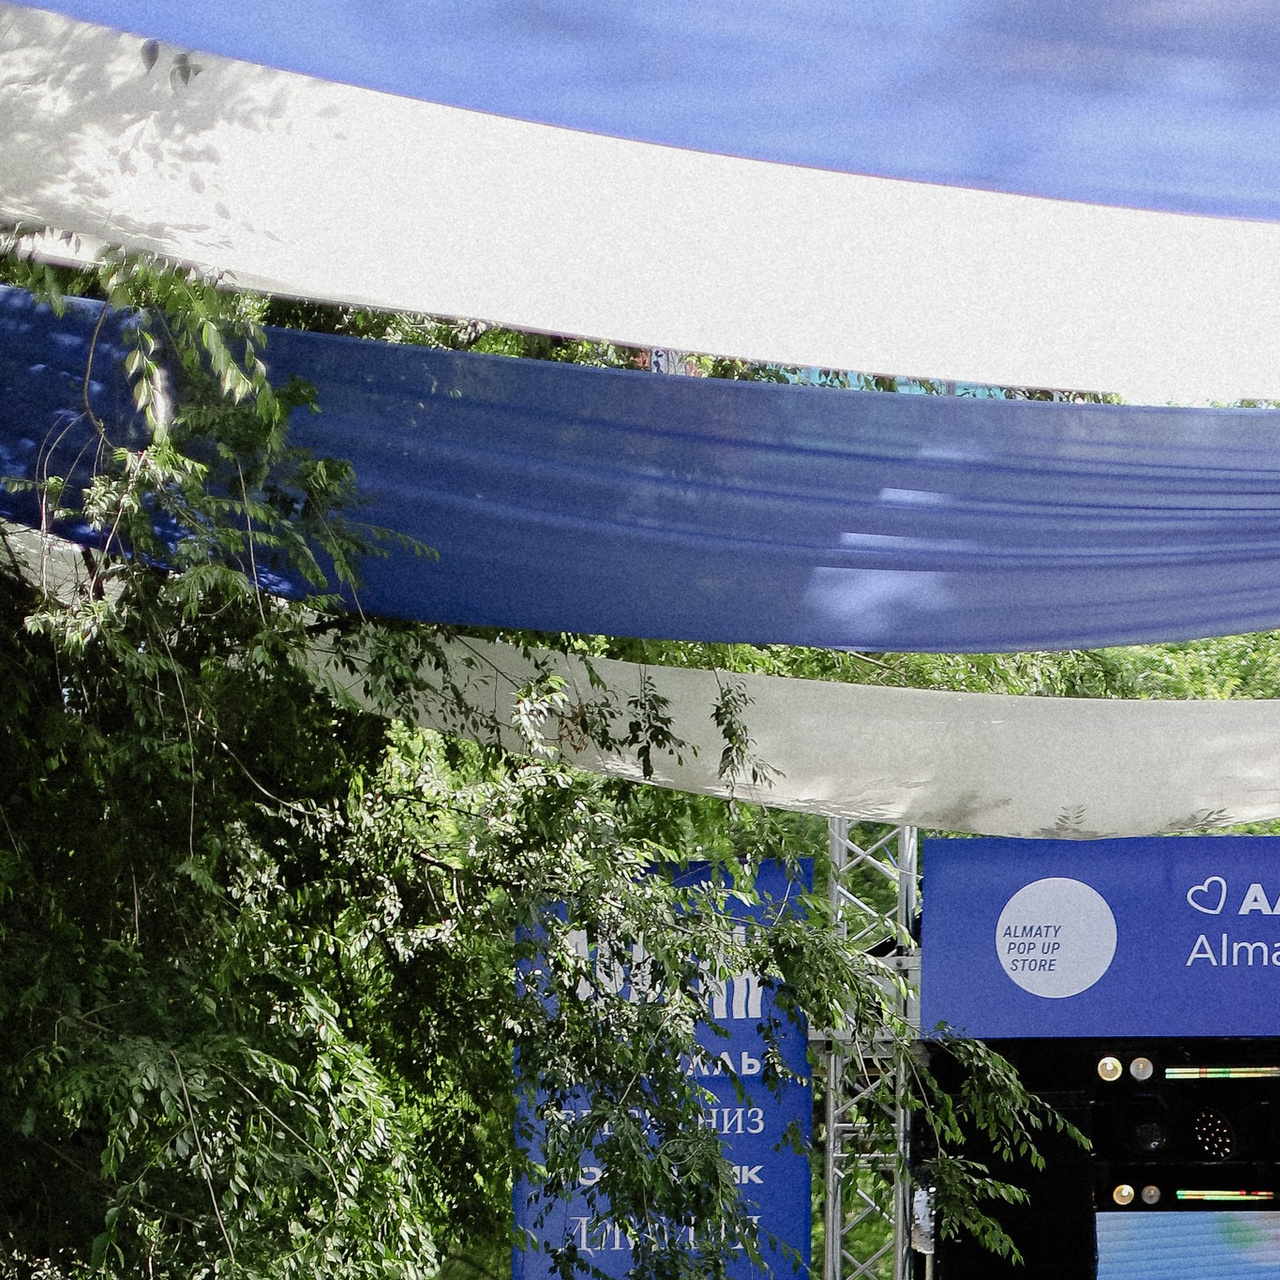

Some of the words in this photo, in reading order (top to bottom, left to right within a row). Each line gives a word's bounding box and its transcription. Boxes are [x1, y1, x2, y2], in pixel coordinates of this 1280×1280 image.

[1003, 925, 1061, 938] ALMATY
[1007, 942, 1036, 955] POP
[1041, 942, 1060, 955] UP
[1010, 958, 1057, 971] STORE
